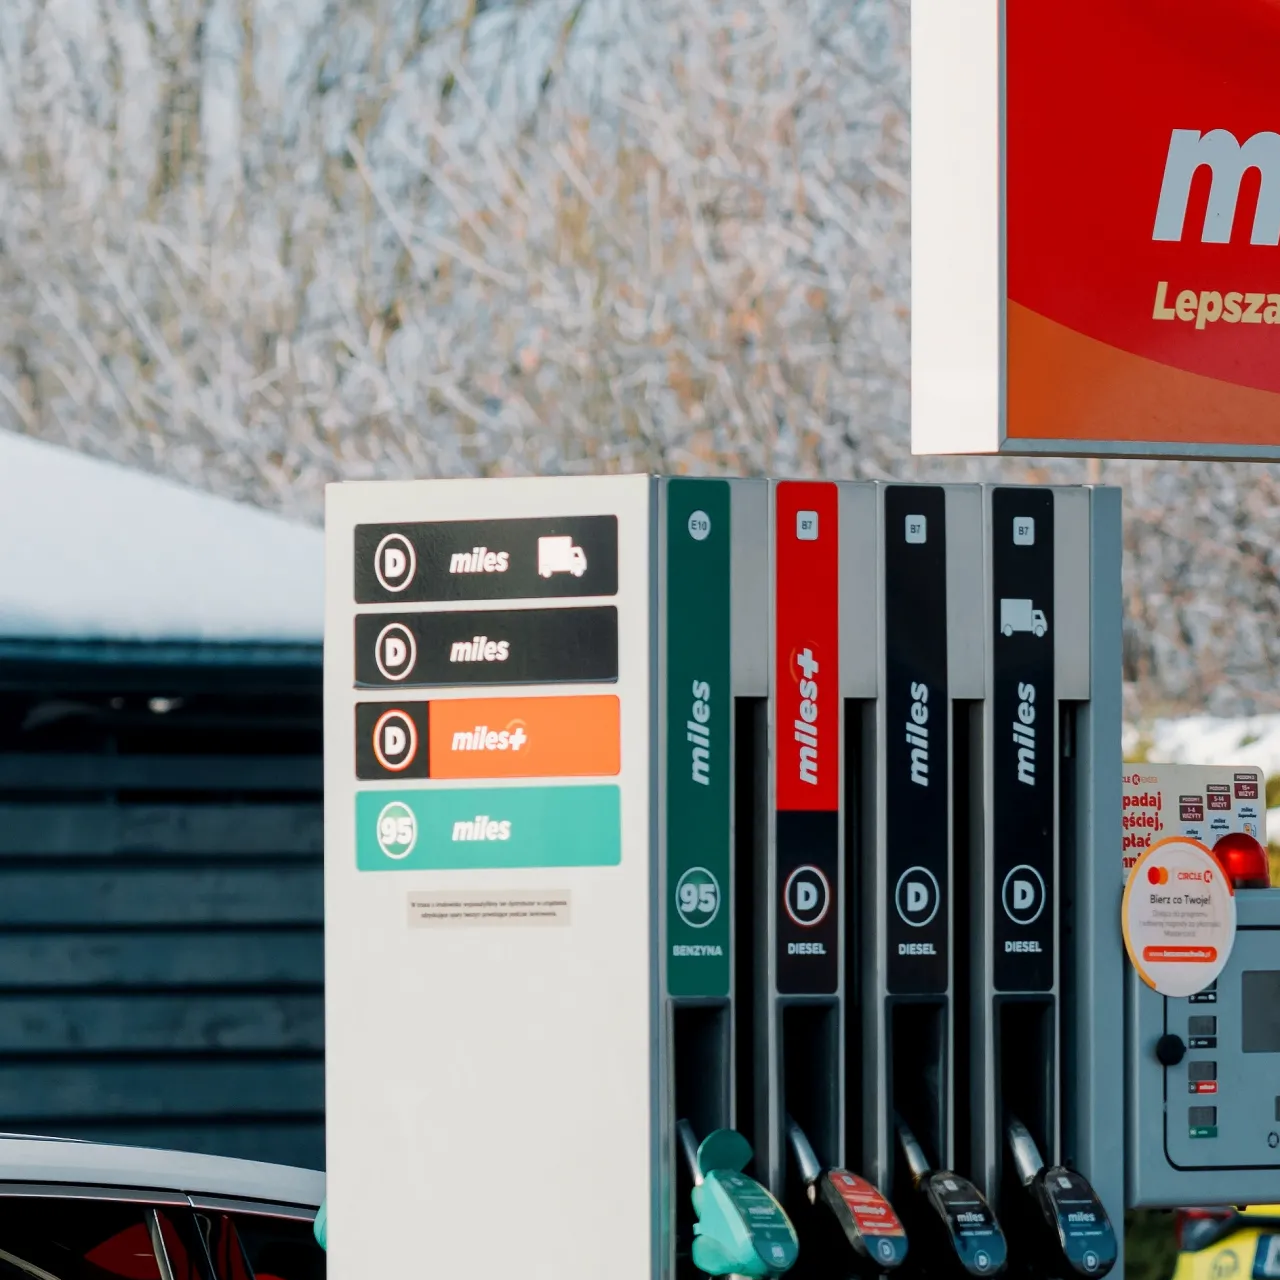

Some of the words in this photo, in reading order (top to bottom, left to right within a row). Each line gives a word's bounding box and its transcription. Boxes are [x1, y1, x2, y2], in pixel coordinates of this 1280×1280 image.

[691, 520, 707, 530] E10
[801, 520, 813, 530] B7
[910, 524, 921, 534] B7
[1018, 526, 1029, 536] B7
[385, 549, 406, 577] D
[449, 547, 509, 573] miles
[385, 638, 406, 666] D
[450, 636, 509, 662] miles
[794, 648, 819, 785] miles+
[384, 726, 406, 755] D
[451, 726, 527, 751] miles+
[687, 680, 710, 786] miles
[906, 681, 929, 786] miles
[1012, 682, 1036, 786] miles
[380, 817, 413, 844] 95
[452, 815, 511, 841] miles
[1122, 833, 1151, 851] płać
[1177, 872, 1202, 880] CIRCLE
[679, 883, 716, 912] 95
[796, 881, 818, 910] D
[906, 882, 928, 911] D
[1013, 880, 1034, 909] D
[1150, 894, 1171, 904] Bierz
[1184, 894, 1211, 907] Twoje!
[673, 945, 723, 956] BENZYNA
[788, 943, 826, 954] DIESEL
[898, 943, 936, 955] DIESEL
[1005, 941, 1042, 952] DIESEL
[957, 1212, 985, 1222] miles
[1068, 1212, 1095, 1222] miles
